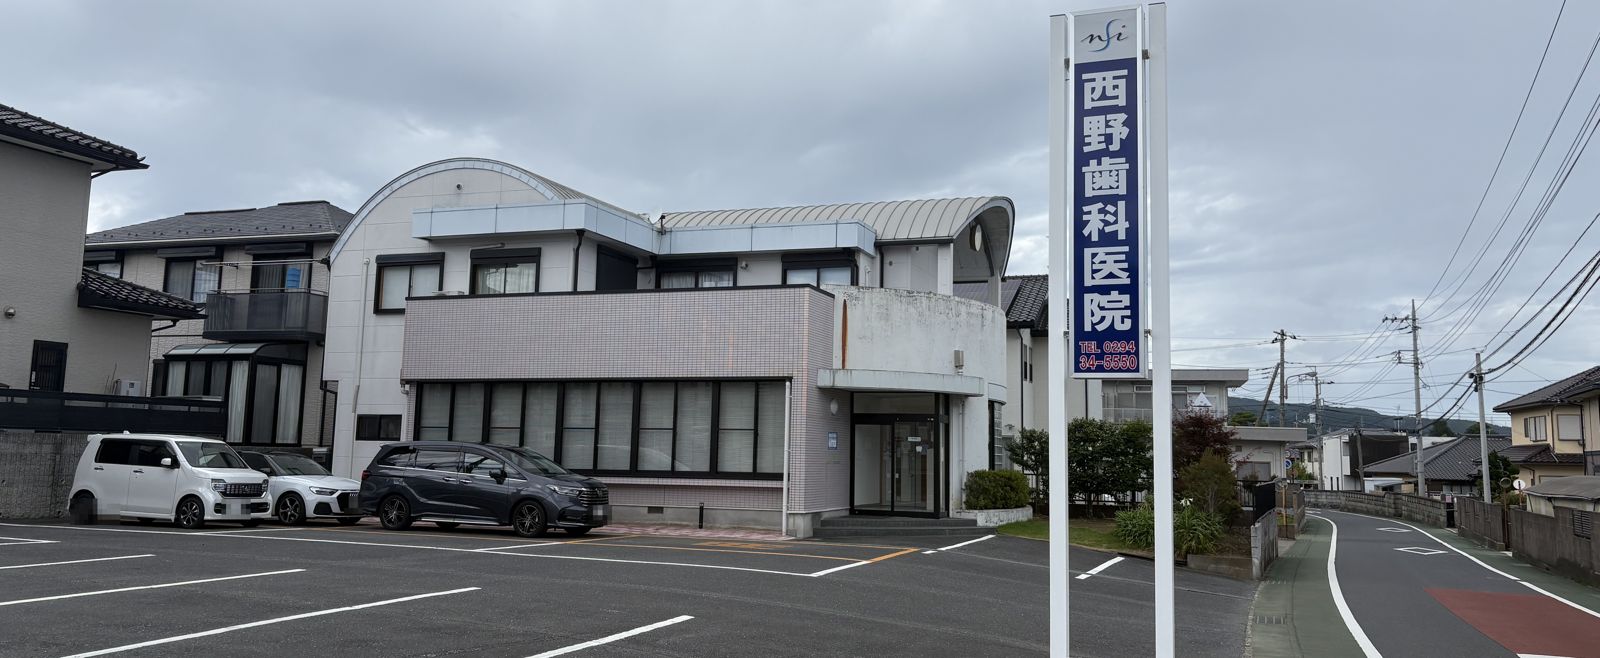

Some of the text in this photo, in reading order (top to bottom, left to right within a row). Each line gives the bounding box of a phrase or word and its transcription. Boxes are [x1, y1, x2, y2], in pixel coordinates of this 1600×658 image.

[1082, 69, 1132, 332] 西野歯科医院
[1079, 341, 1136, 353] TEL 0294
[1079, 355, 1137, 370] 34-5550
